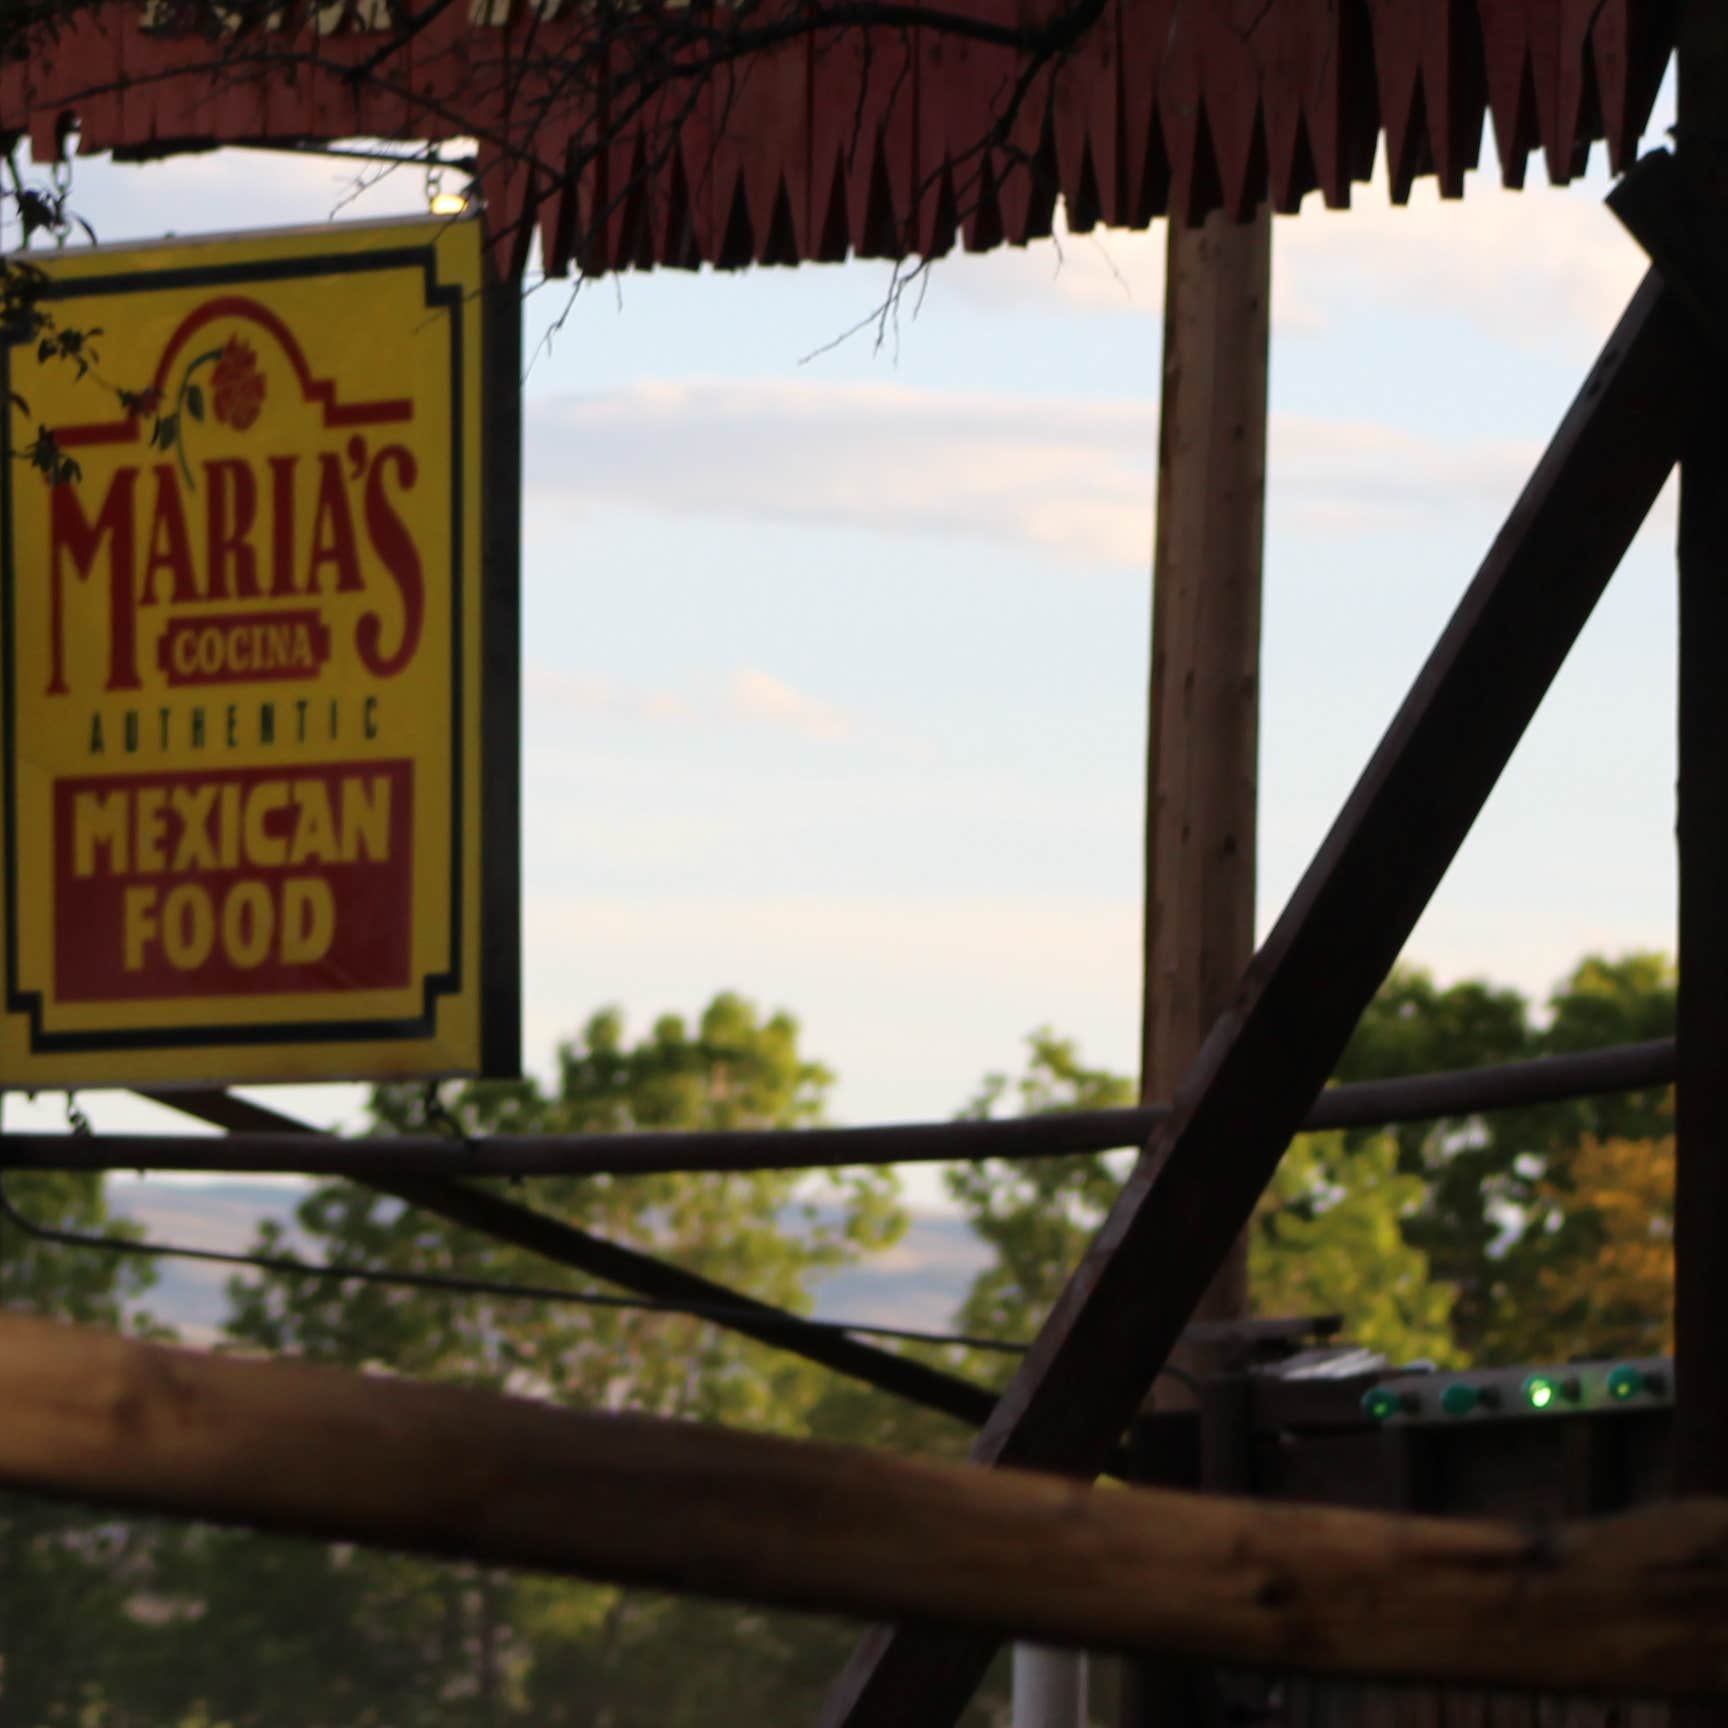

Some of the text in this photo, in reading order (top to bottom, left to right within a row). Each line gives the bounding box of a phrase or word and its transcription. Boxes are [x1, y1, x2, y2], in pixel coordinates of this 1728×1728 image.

[45, 434, 426, 697] MARIA'S
[173, 619, 314, 676] COCINA
[89, 696, 381, 756] AUTHENTIC
[73, 775, 394, 878] MEXICAN
[124, 877, 337, 973] FOOD
